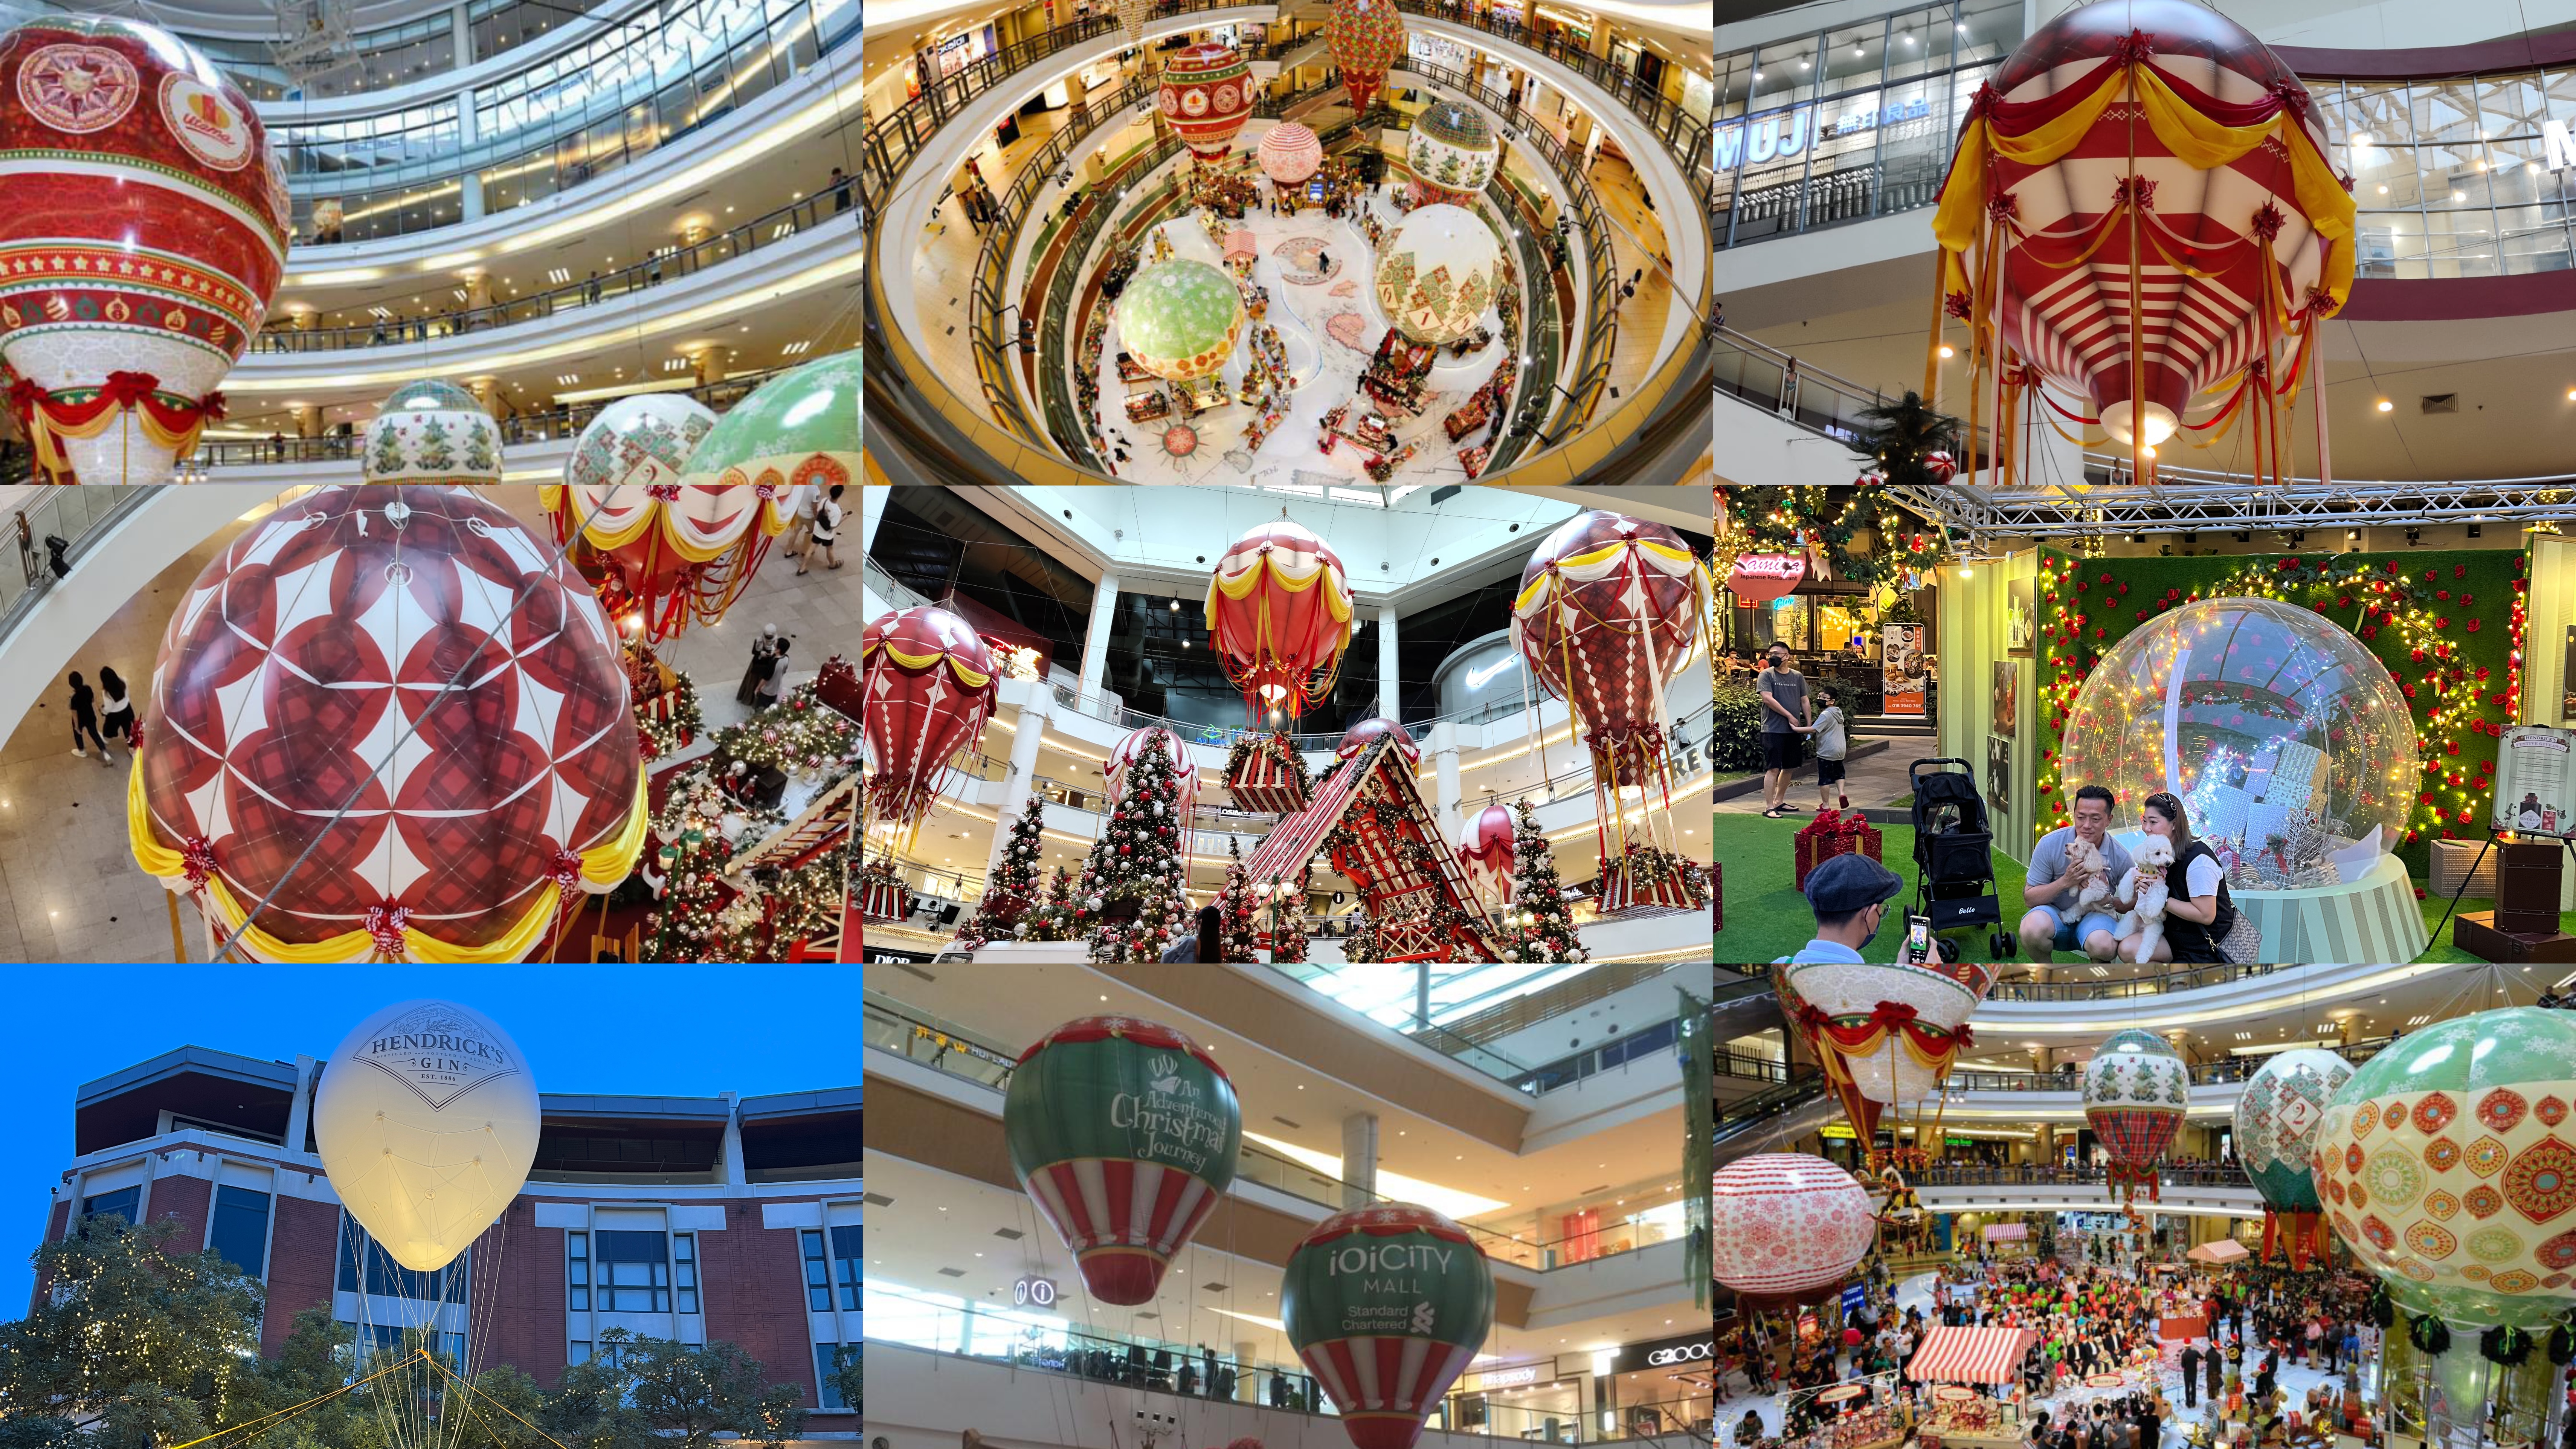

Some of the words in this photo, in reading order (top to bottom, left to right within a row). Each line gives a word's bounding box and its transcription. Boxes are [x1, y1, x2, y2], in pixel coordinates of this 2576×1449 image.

[1837, 97, 1930, 134] 無印良品
[183, 113, 236, 145] Utama
[1713, 107, 1822, 172] MUJI
[1734, 558, 1804, 577] amiya
[1774, 596, 1795, 610] Bar
[2539, 742, 2566, 751] GIVEAWAY
[372, 1034, 504, 1064] HENDRICK'S
[421, 1057, 459, 1071] GIN
[470, 1057, 500, 1068] SCOTLAND
[1180, 1080, 1200, 1099] An
[1145, 1091, 1227, 1130] Adventurous
[2292, 1102, 2306, 1125] 2
[1111, 1092, 1225, 1153] Christmas
[1137, 1131, 1207, 1173] Journey
[1364, 1278, 1422, 1294] MALL
[1348, 1305, 1409, 1317] Standard
[1341, 1319, 1407, 1331] Chartered
[1481, 1368, 1536, 1385] Rhapsody
